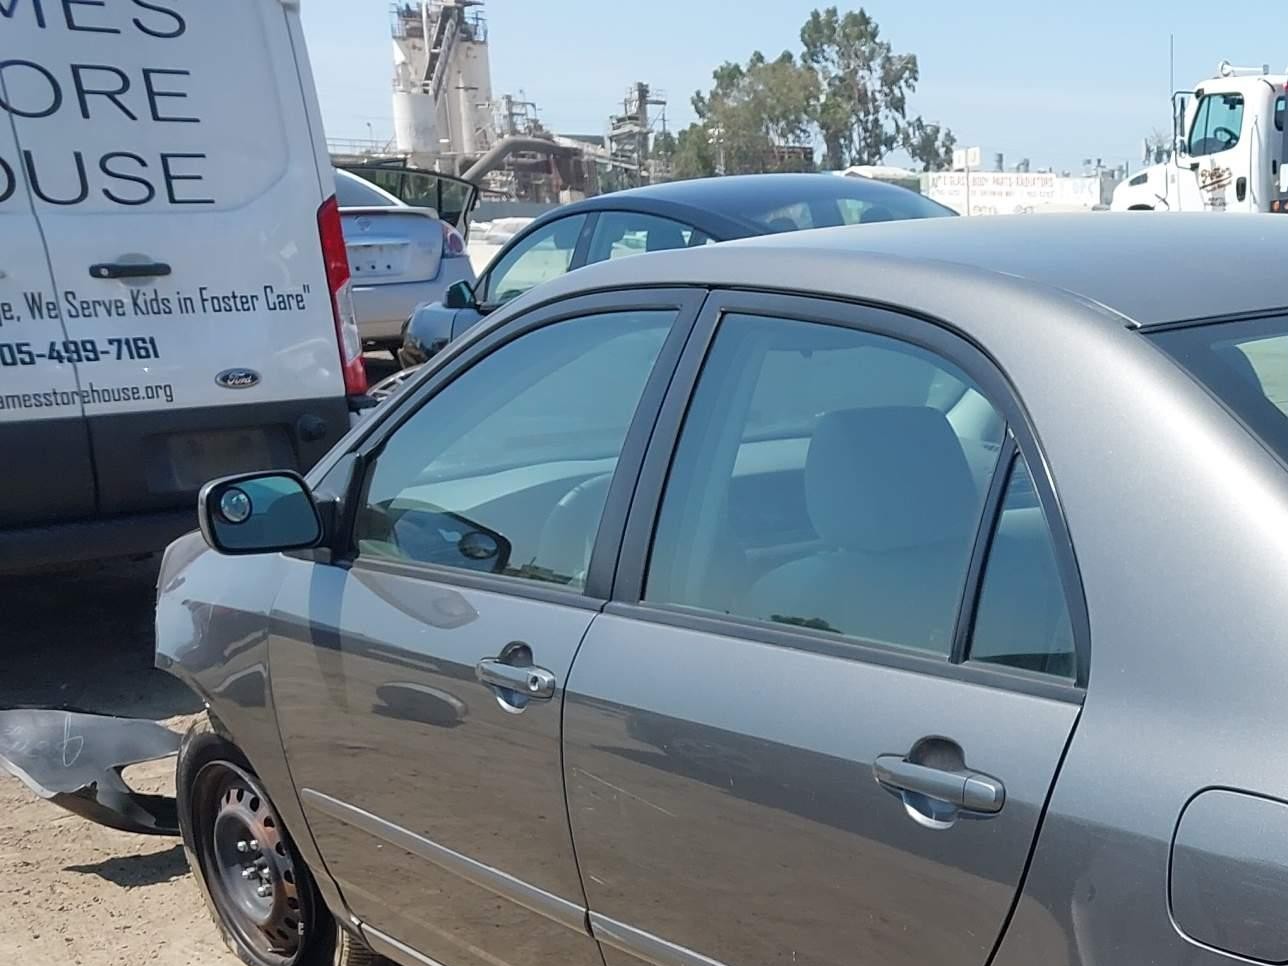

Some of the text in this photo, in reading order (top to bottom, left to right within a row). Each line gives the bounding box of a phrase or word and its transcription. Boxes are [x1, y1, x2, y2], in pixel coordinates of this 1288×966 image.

[0, 0, 187, 39] ES
[0, 59, 201, 123] ORE
[0, 150, 216, 206] USE
[23, 291, 59, 320] We
[64, 290, 126, 318] Serve
[129, 288, 173, 316] Kids
[176, 291, 196, 314] in
[199, 286, 259, 313] Foster
[263, 283, 310, 311] Care"
[0, 336, 160, 366] 05-499-7161
